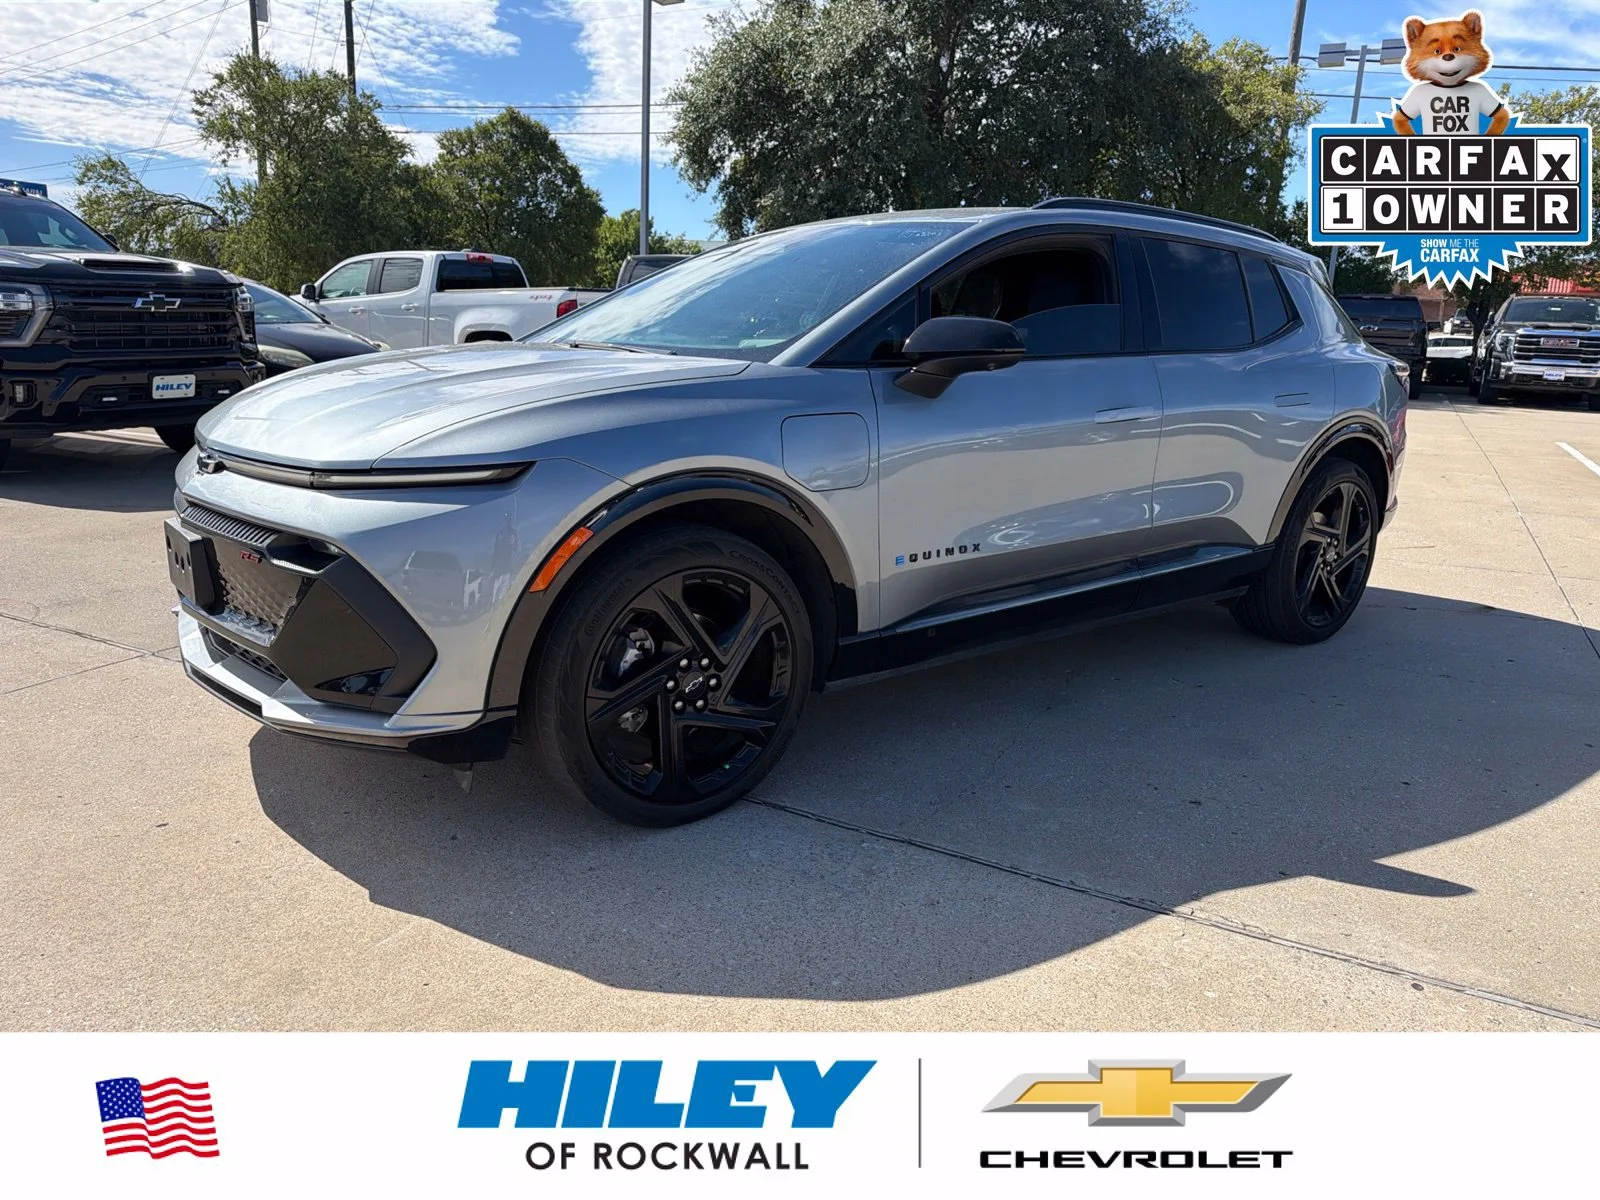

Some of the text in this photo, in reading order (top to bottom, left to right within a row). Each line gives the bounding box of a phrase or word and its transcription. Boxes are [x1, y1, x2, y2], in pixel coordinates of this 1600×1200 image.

[155, 383, 192, 391] HILEY
[240, 550, 260, 564] RS
[895, 543, 981, 566] EQUINOX
